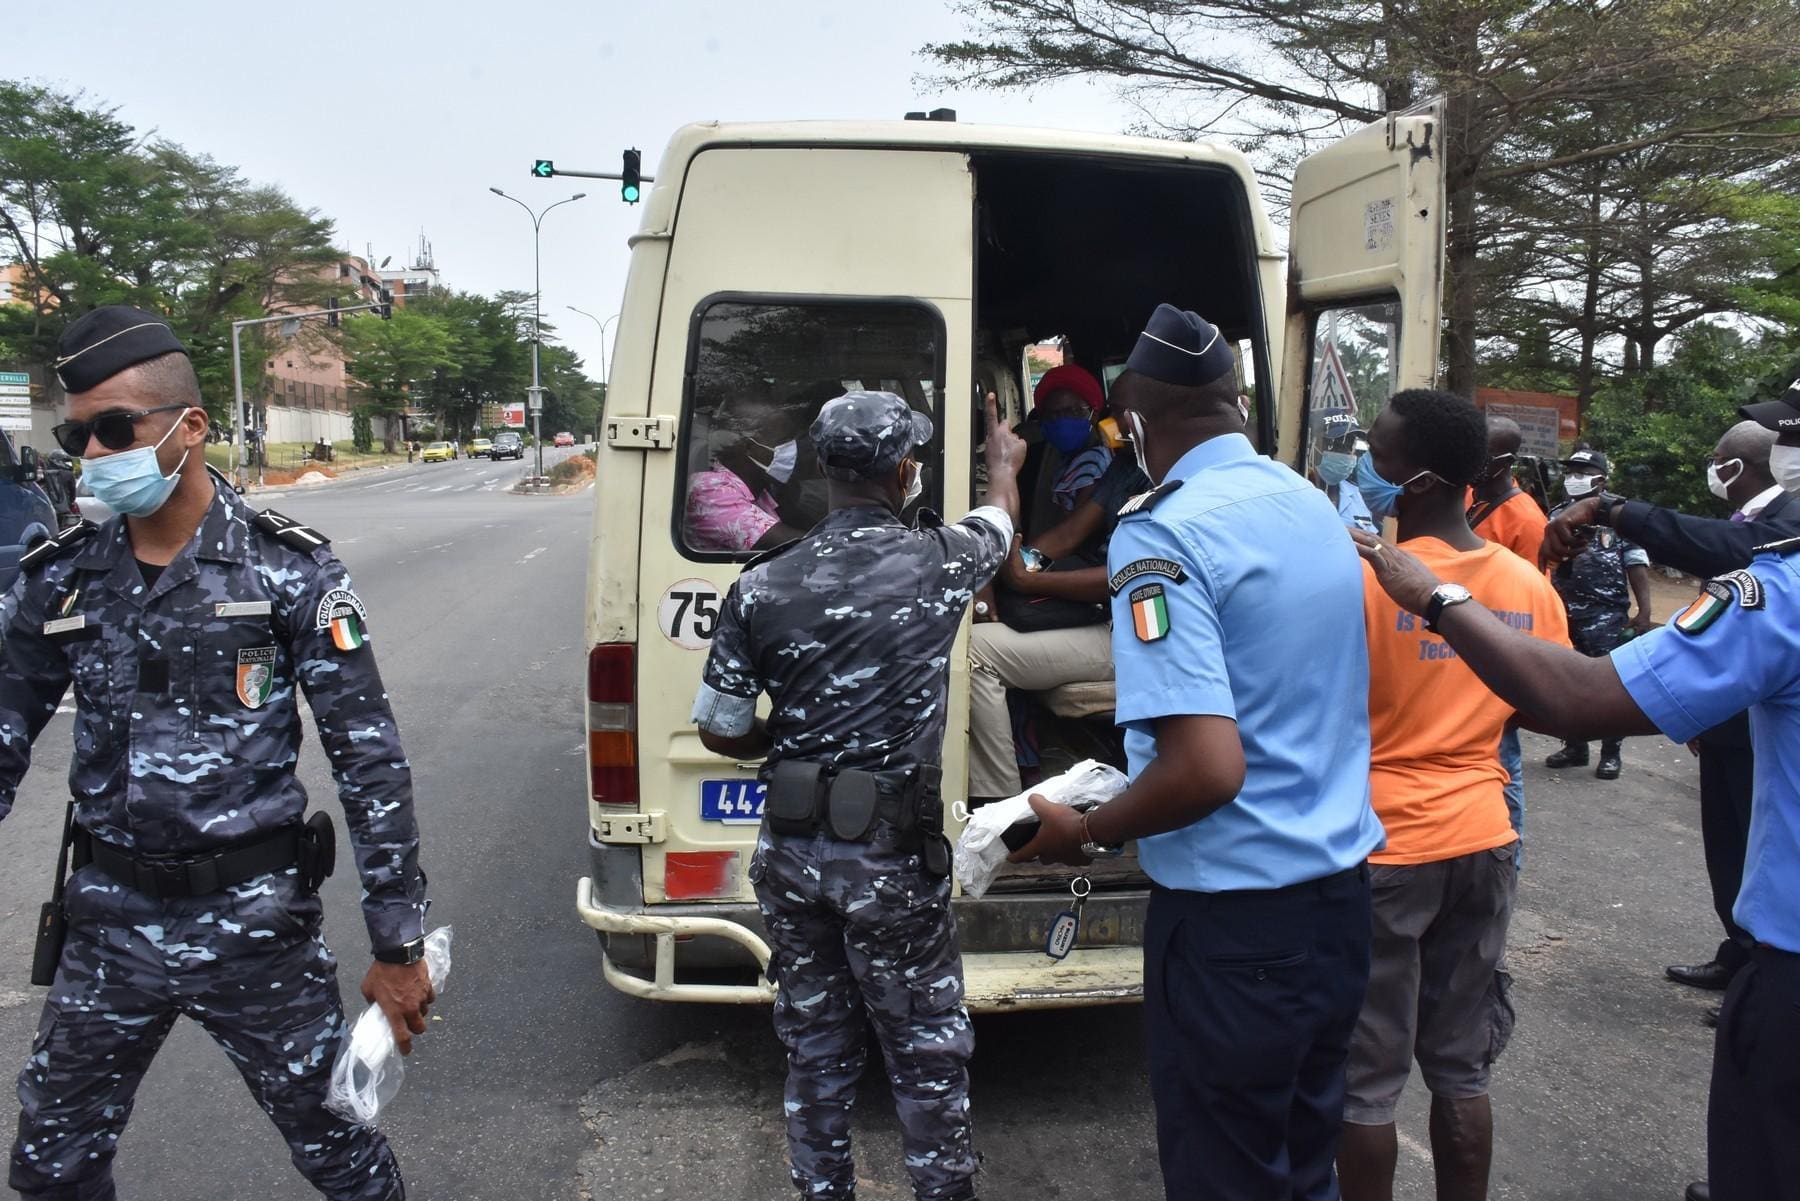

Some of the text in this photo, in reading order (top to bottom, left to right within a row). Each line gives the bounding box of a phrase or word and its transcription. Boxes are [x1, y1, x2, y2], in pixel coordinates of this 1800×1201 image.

[1113, 560, 1178, 587] POLICE NATIONALE
[320, 596, 333, 625] POLICE
[331, 591, 366, 618] NATIONALE
[670, 592, 719, 639] 75
[241, 650, 275, 658] POLICE
[717, 783, 767, 815] 442
[1058, 927, 1071, 952] SUZUKI
